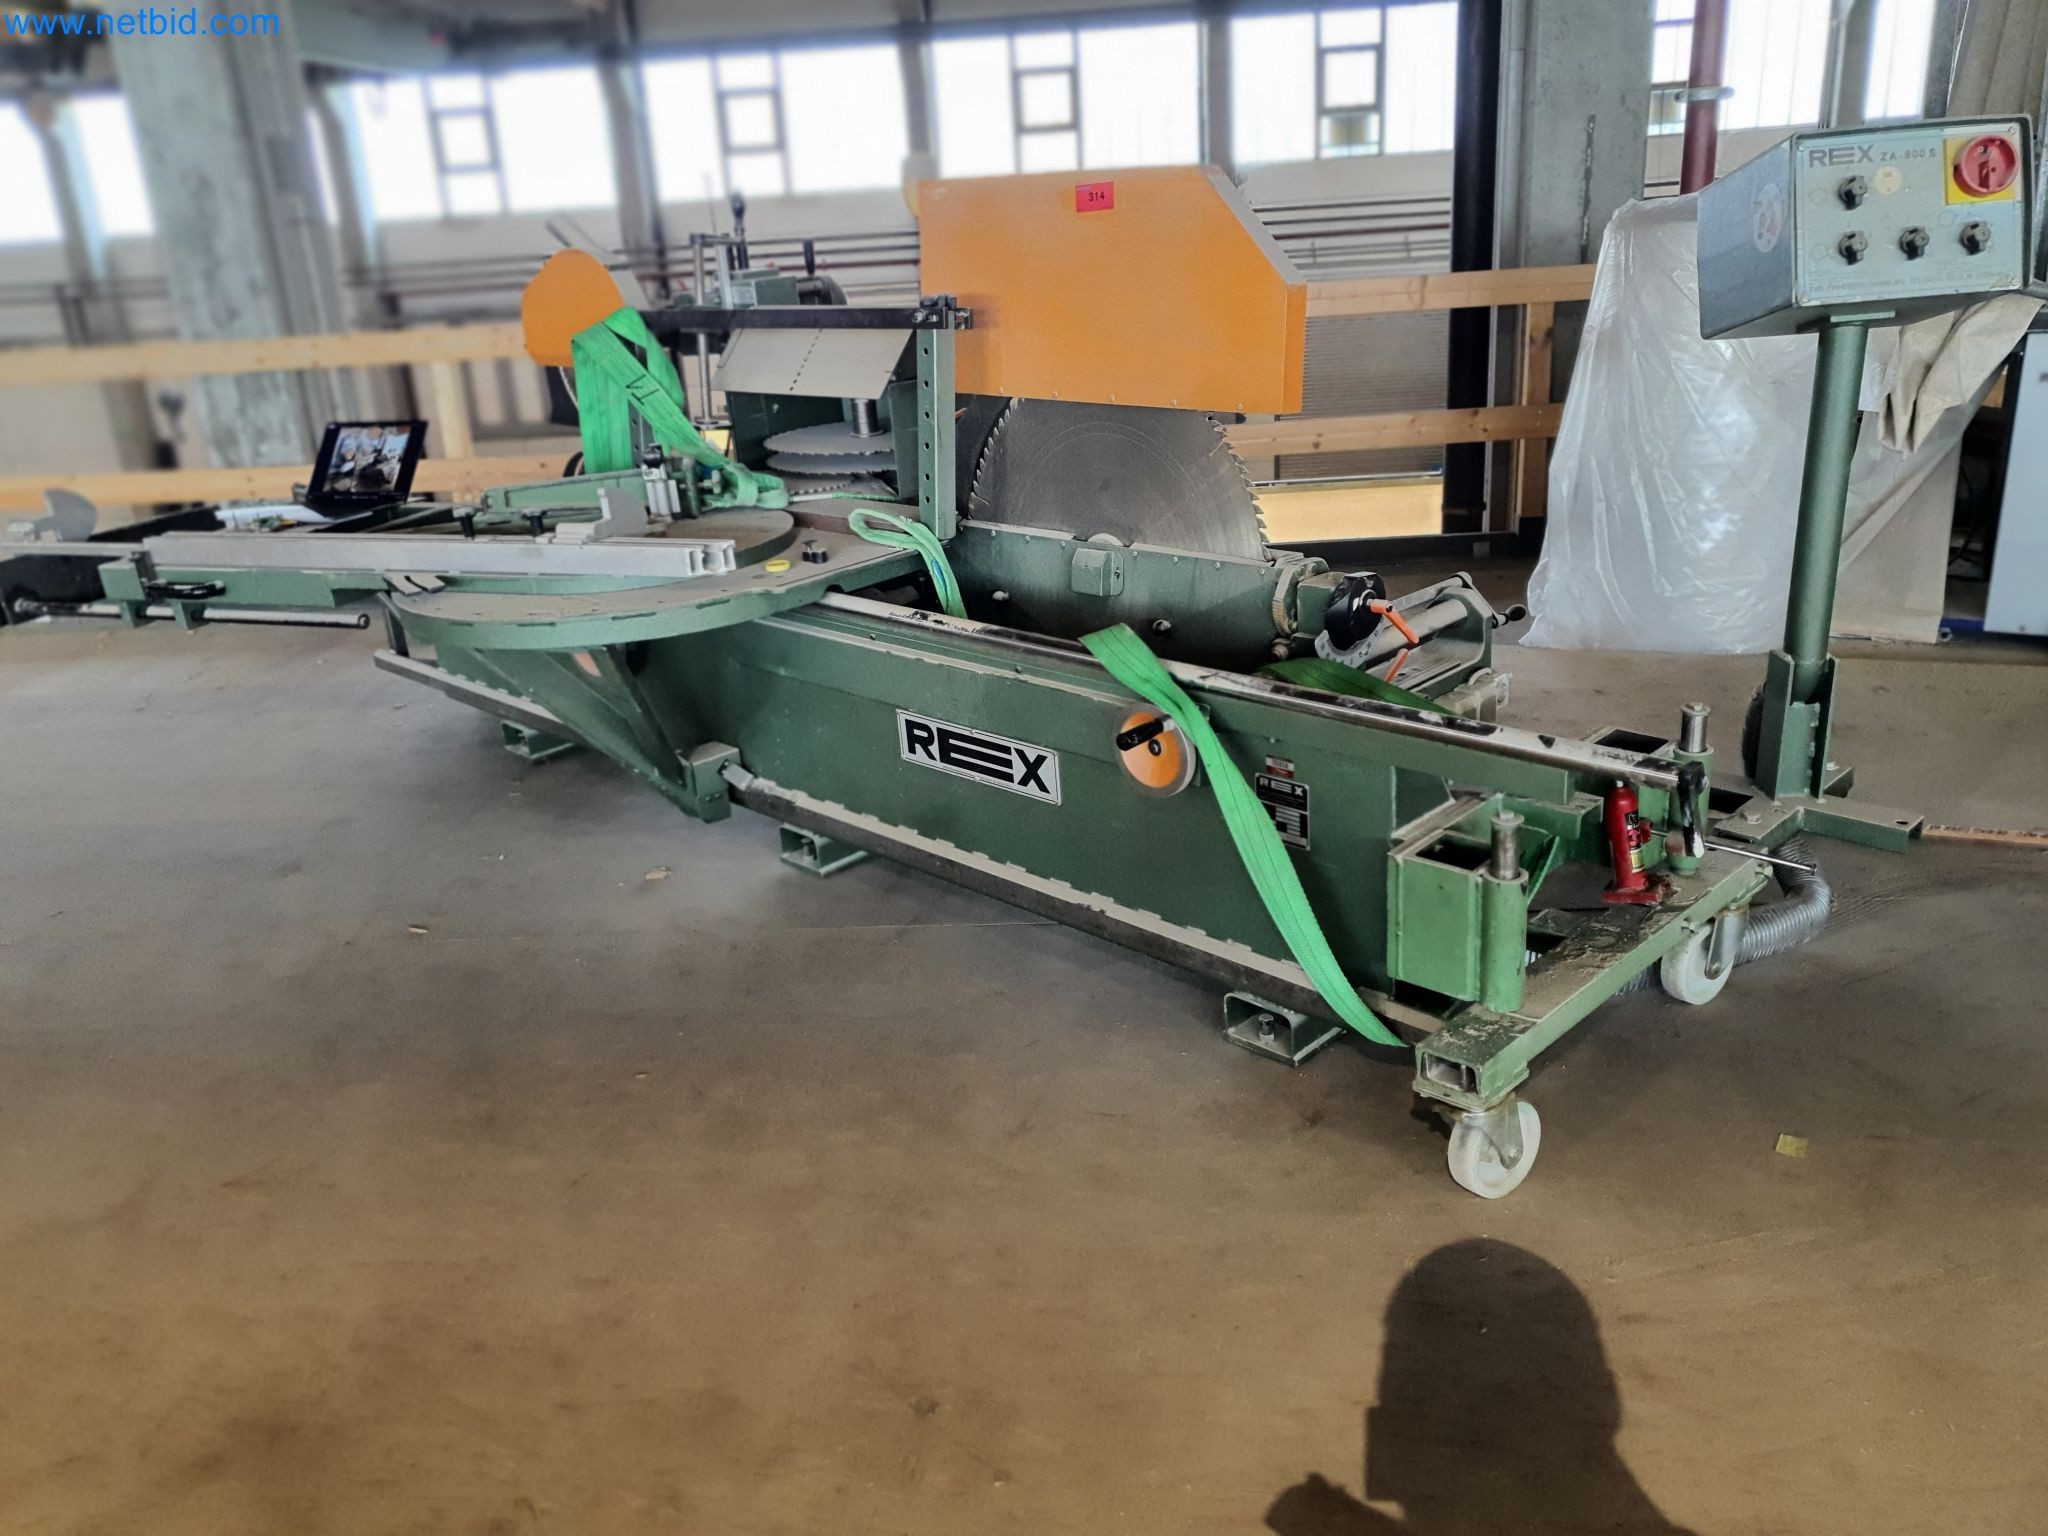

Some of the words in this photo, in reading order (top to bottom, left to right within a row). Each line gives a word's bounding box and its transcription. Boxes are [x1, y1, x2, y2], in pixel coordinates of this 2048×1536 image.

[1809, 144, 1874, 168] REX
[1088, 191, 1105, 202] 314
[905, 719, 1051, 794] REX
[1259, 777, 1304, 796] REX
